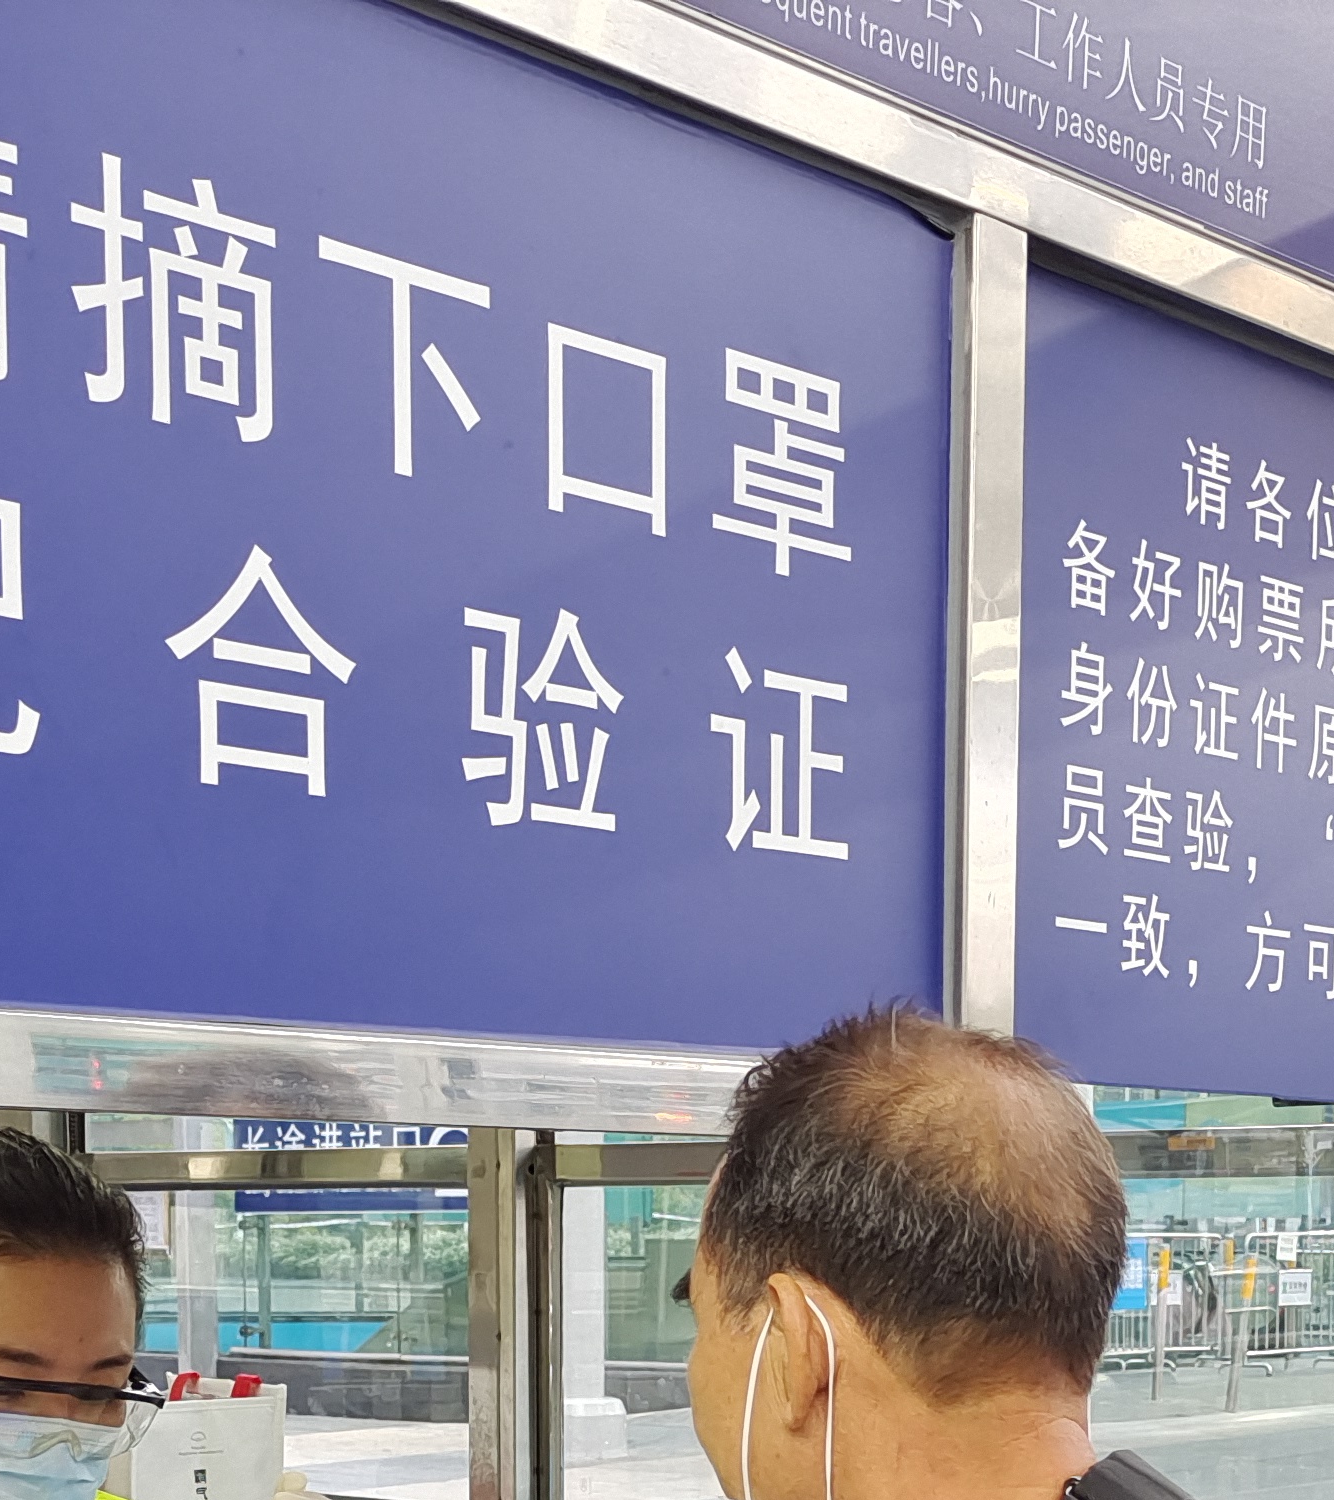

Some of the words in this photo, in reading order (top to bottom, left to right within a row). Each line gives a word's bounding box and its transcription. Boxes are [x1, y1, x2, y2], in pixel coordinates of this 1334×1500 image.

[928, 0, 1269, 170] 、工作人员专用
[1055, 106, 1175, 184] passenger,
[1182, 159, 1220, 198] and
[1224, 178, 1270, 220] staff
